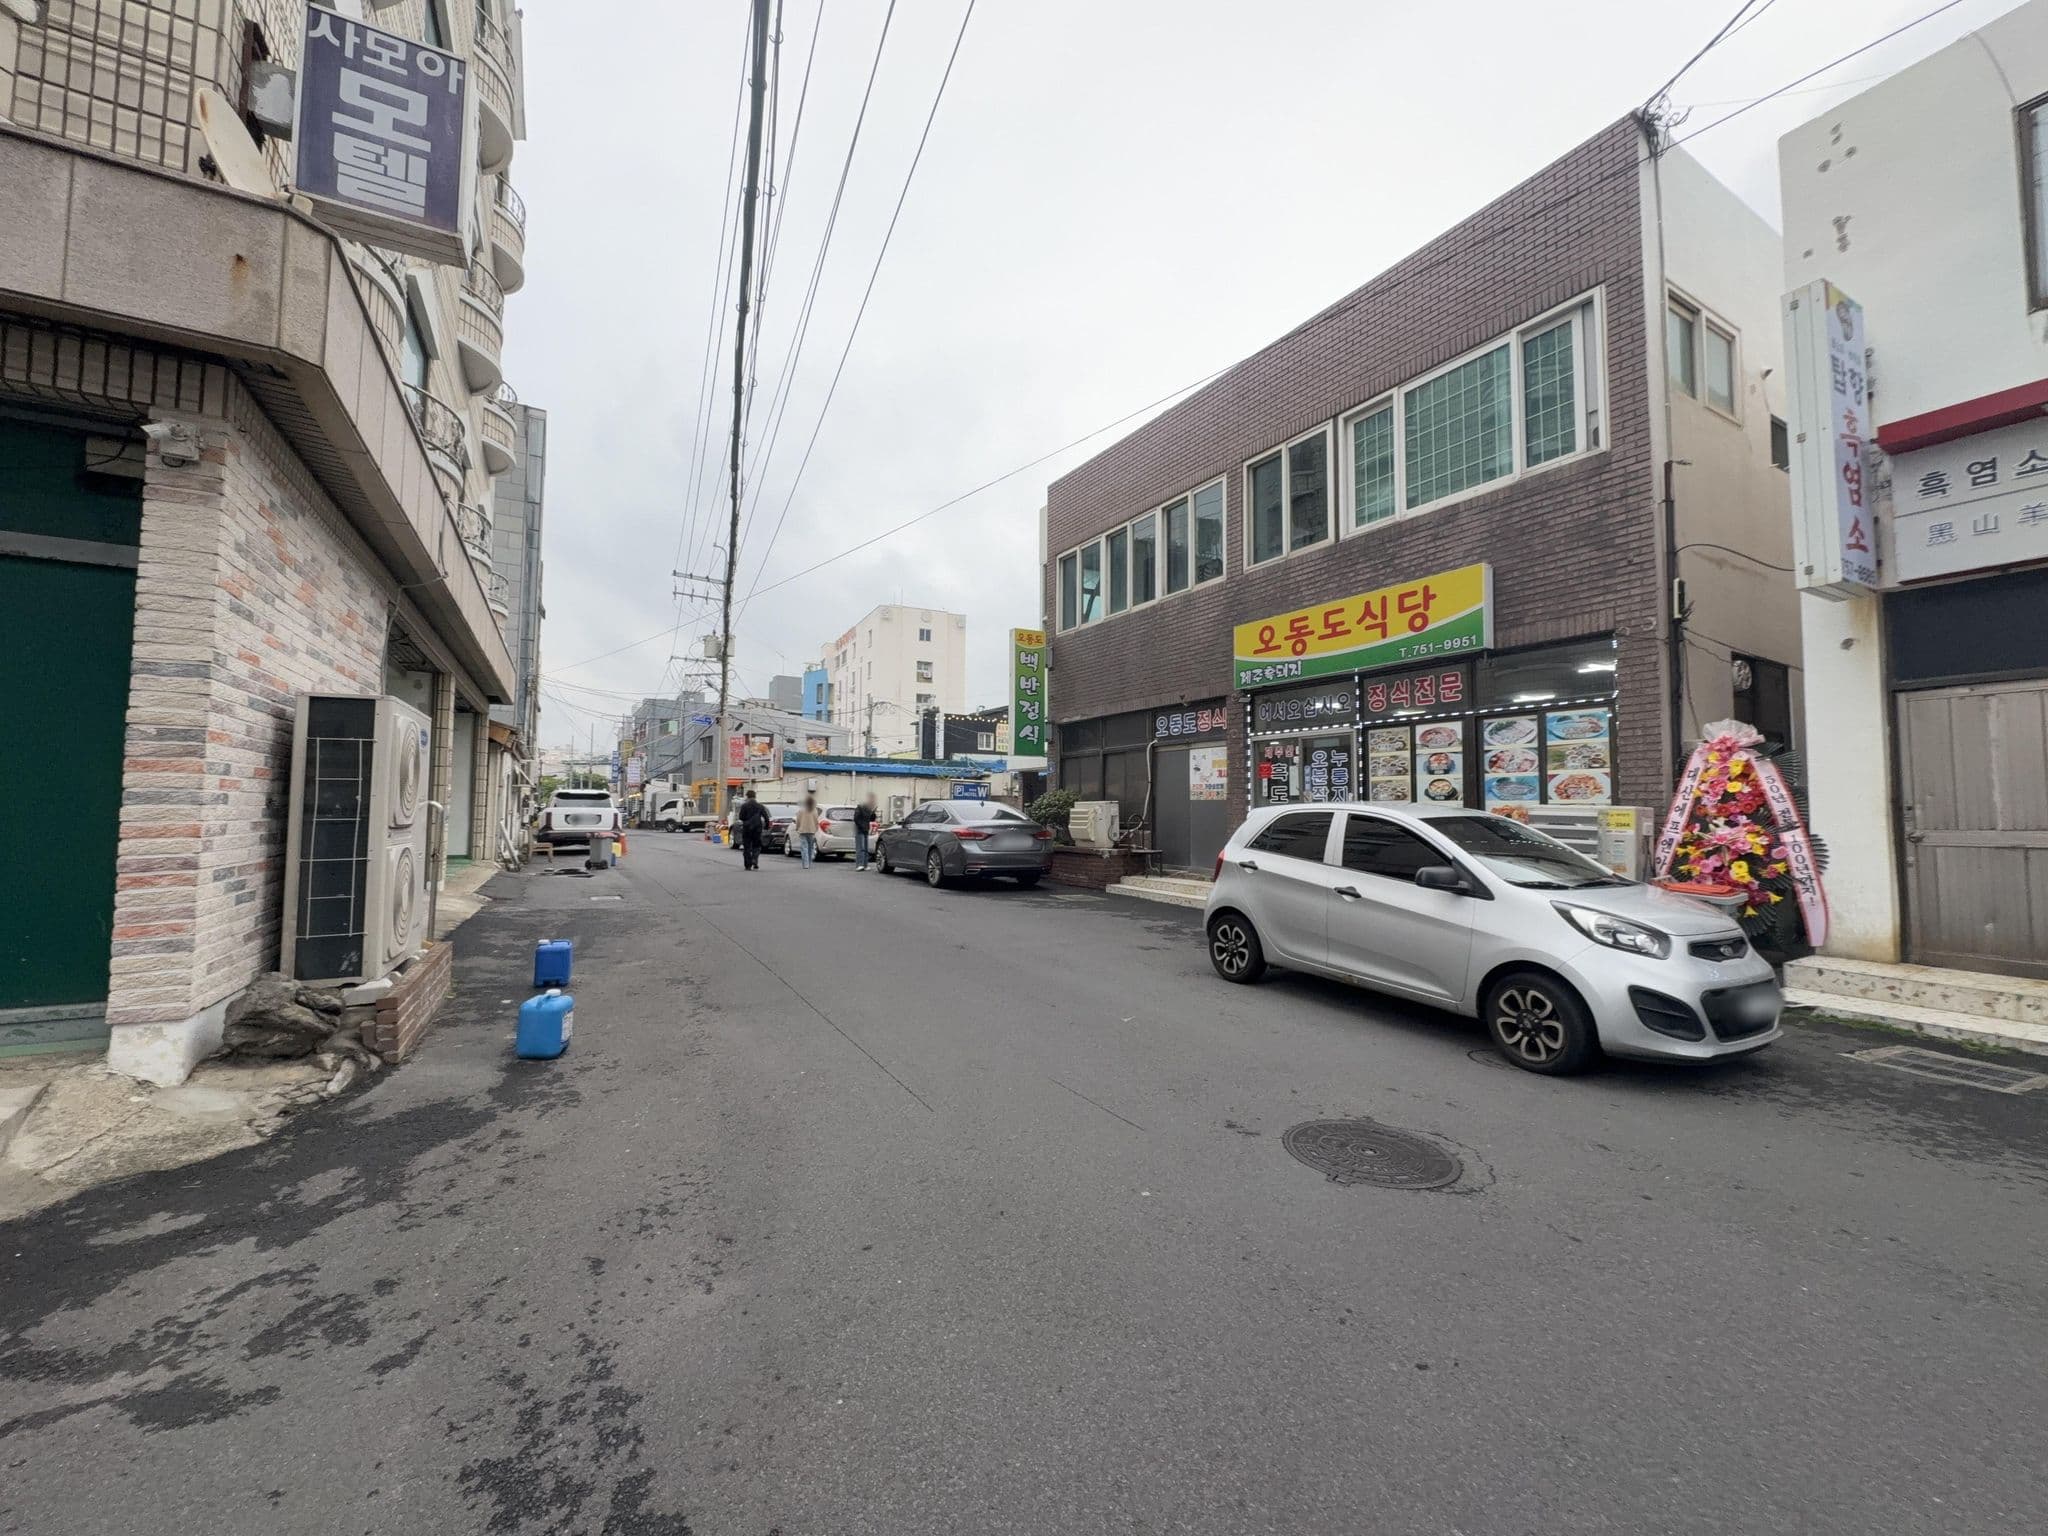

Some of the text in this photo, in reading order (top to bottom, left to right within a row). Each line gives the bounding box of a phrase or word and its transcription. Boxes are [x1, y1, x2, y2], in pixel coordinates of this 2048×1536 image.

[308, 13, 463, 94] 사모아
[332, 67, 431, 217] 모텔
[1839, 407, 1868, 552] 흑염소
[1917, 449, 2048, 497] 흑염소
[1018, 633, 1043, 645] 오동도
[1253, 584, 1437, 656] 오동도식당
[1399, 634, 1477, 658] T.751-9951
[1240, 660, 1302, 684] 제주흑돼지
[1367, 671, 1463, 712] 정식전문
[1019, 651, 1040, 744] 백반정식
[1259, 692, 1351, 721] 어서오십시오
